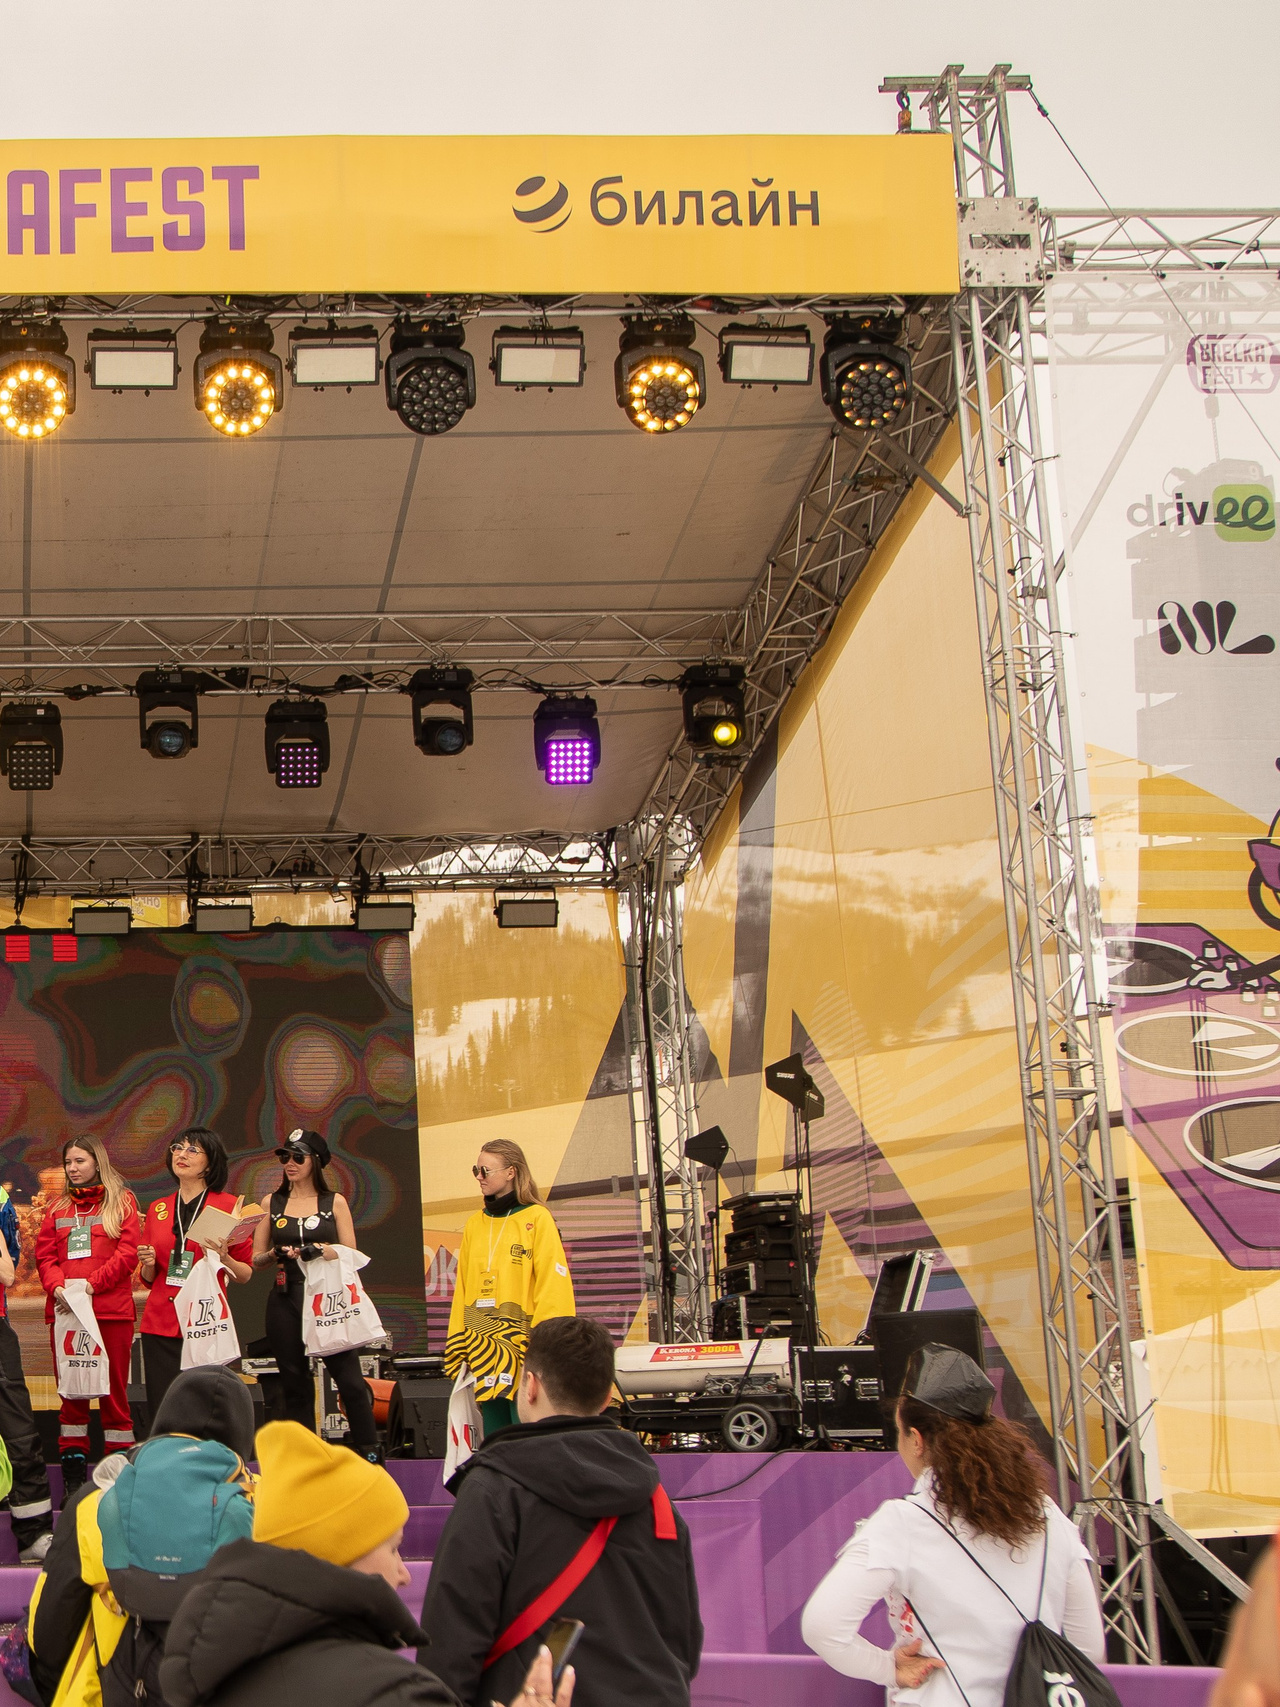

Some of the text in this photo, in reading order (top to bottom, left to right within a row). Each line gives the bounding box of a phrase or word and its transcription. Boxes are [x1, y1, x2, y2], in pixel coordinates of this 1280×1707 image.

[589, 175, 820, 227] билайн
[1200, 343, 1266, 363] GRELKA
[1202, 365, 1246, 385] FEST
[1126, 492, 1276, 532] drivee
[316, 1307, 361, 1327] ROSTC'S
[659, 1345, 736, 1355] KERONA 30000
